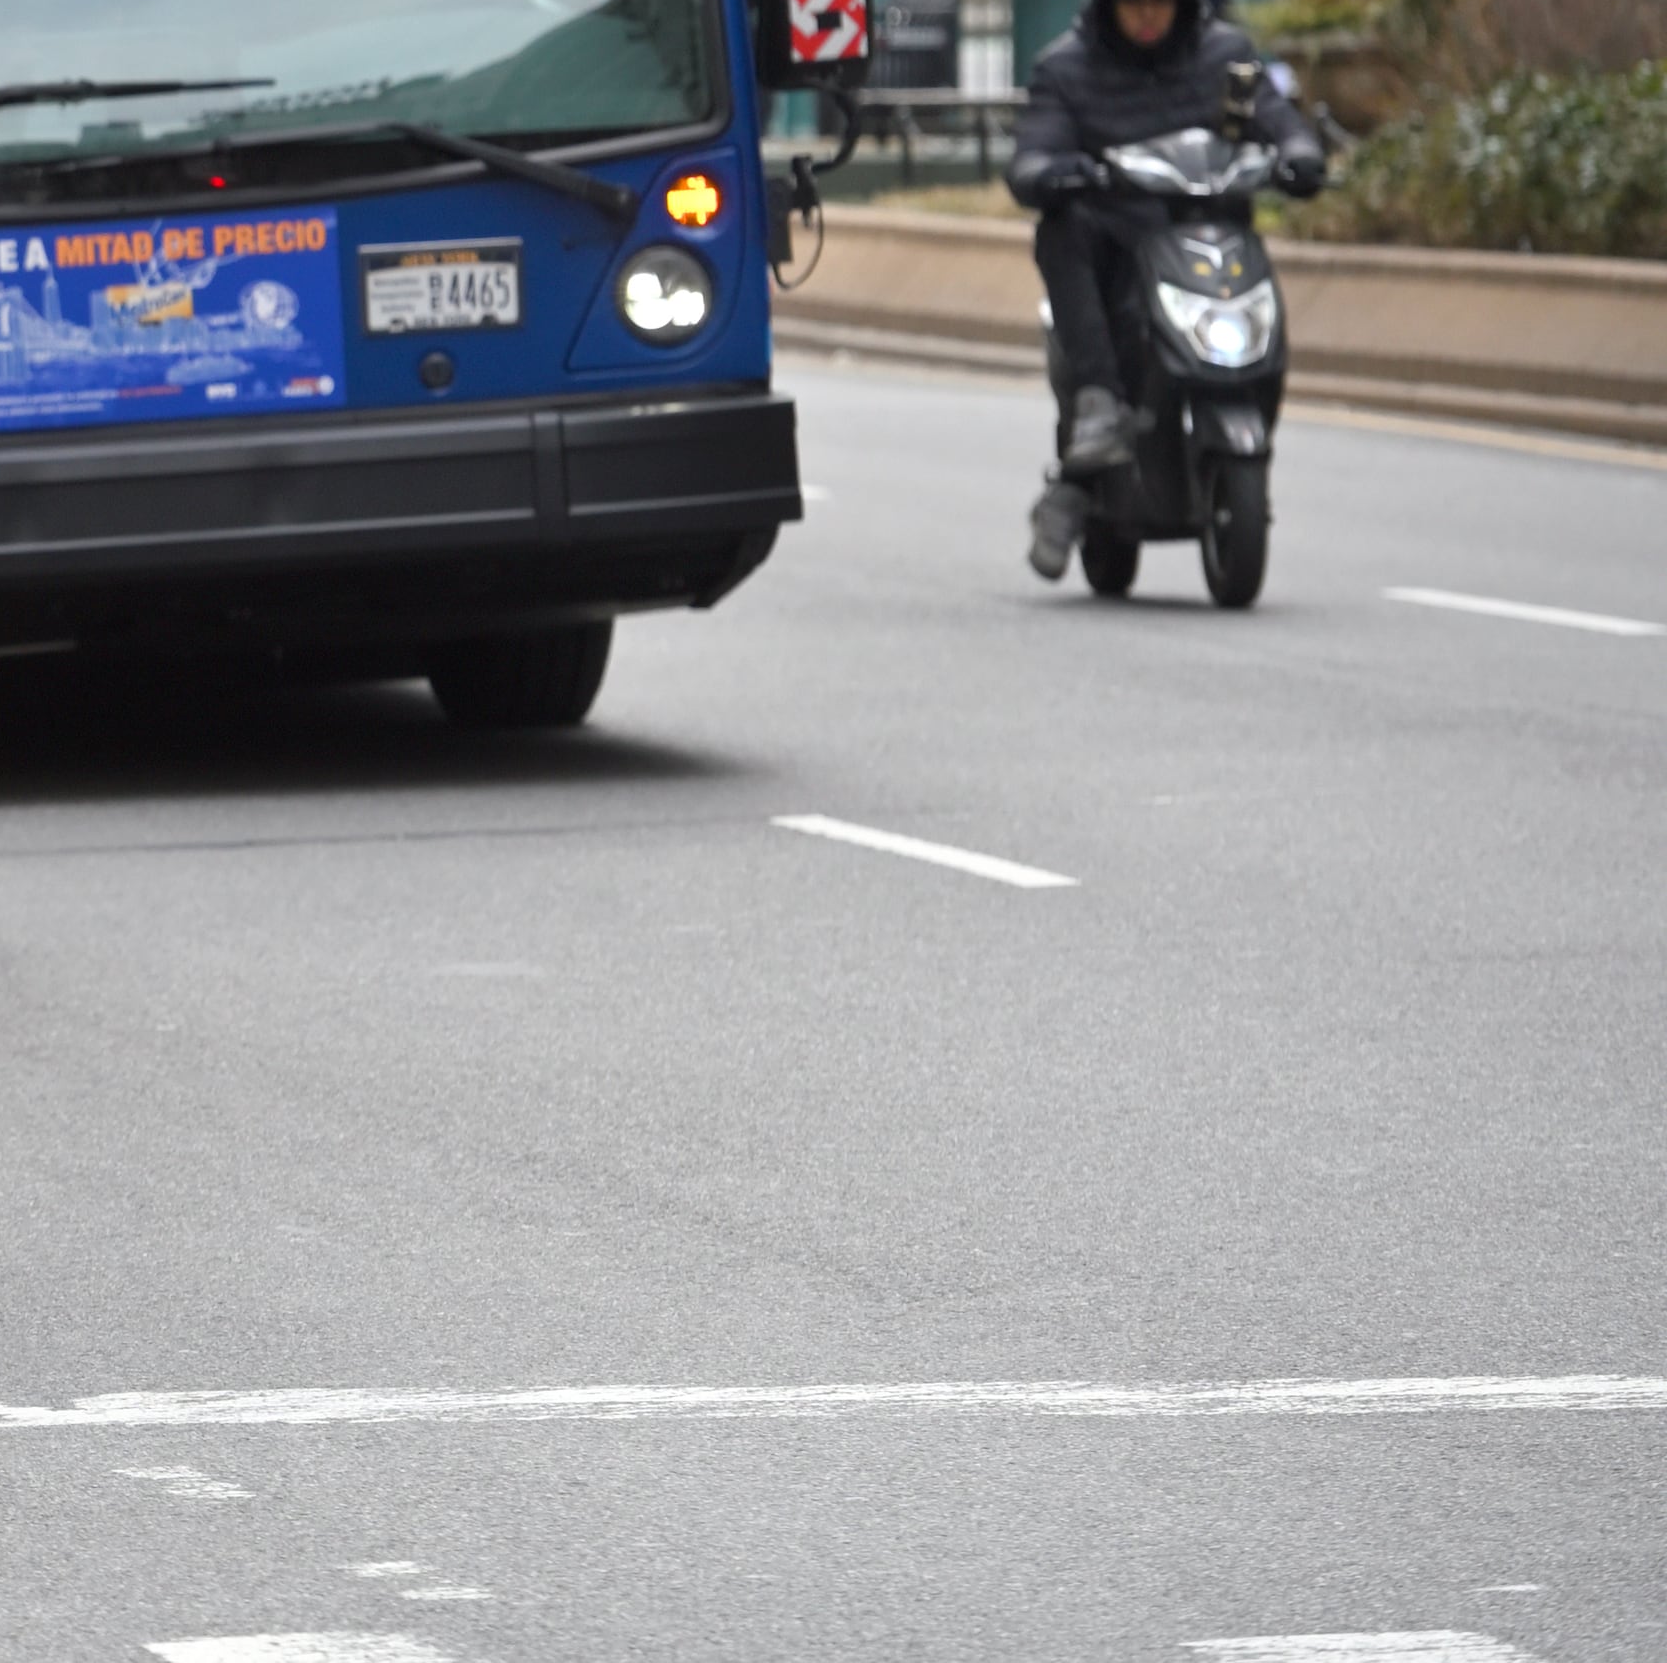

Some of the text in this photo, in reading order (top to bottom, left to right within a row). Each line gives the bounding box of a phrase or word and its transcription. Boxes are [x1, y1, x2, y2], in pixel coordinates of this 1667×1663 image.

[24, 236, 50, 271] A
[55, 232, 155, 268] MITAD
[162, 227, 205, 260] DE
[213, 218, 327, 257] PRECIO
[448, 266, 511, 309] 4465
